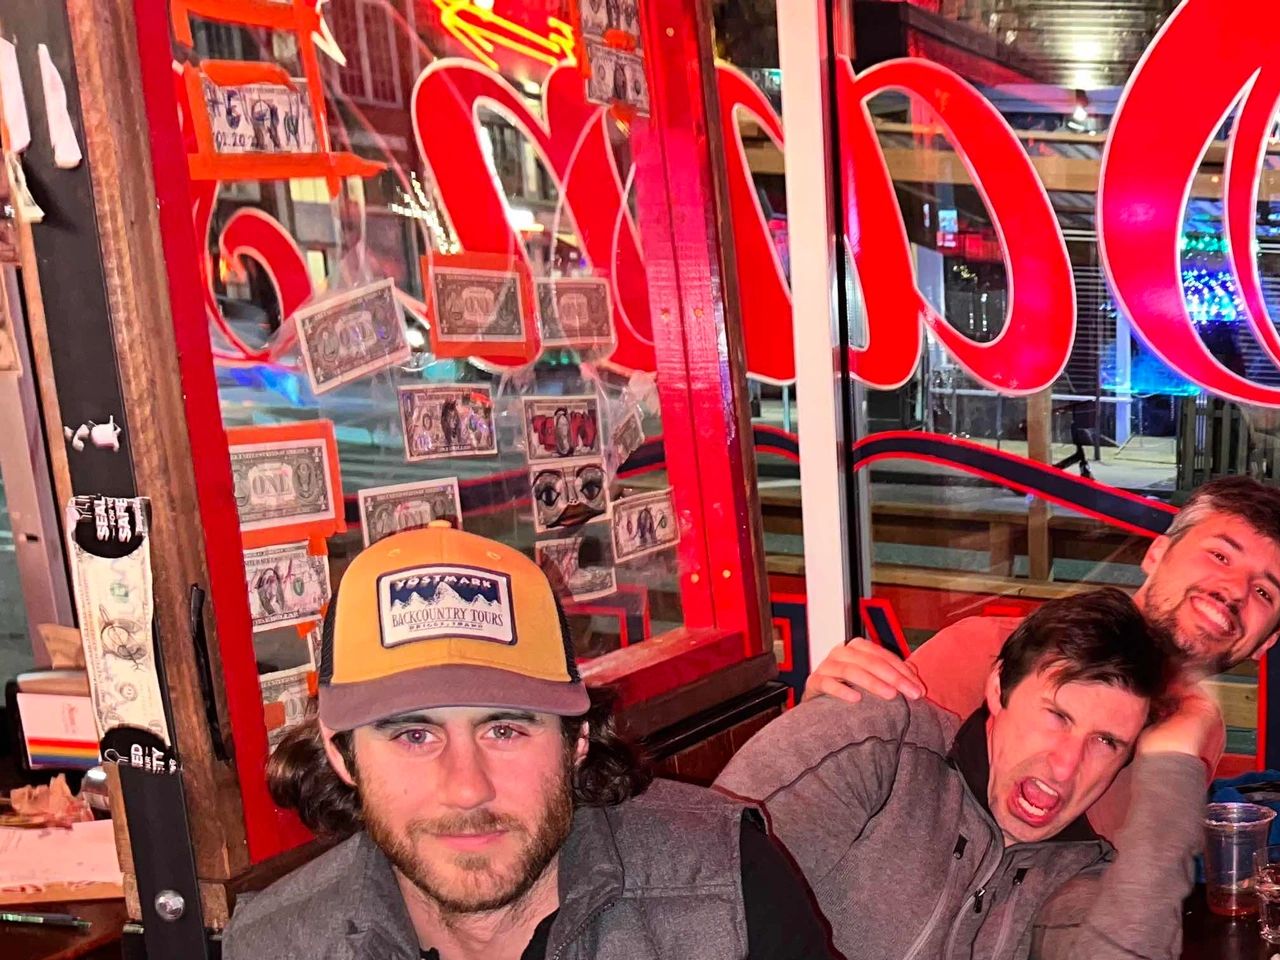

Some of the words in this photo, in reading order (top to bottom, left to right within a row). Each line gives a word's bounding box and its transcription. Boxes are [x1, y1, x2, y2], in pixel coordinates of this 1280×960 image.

[395, 574, 492, 591] YOSTMARK
[391, 606, 467, 628] BACKCOUNTRY
[470, 608, 504, 627] TOURS
